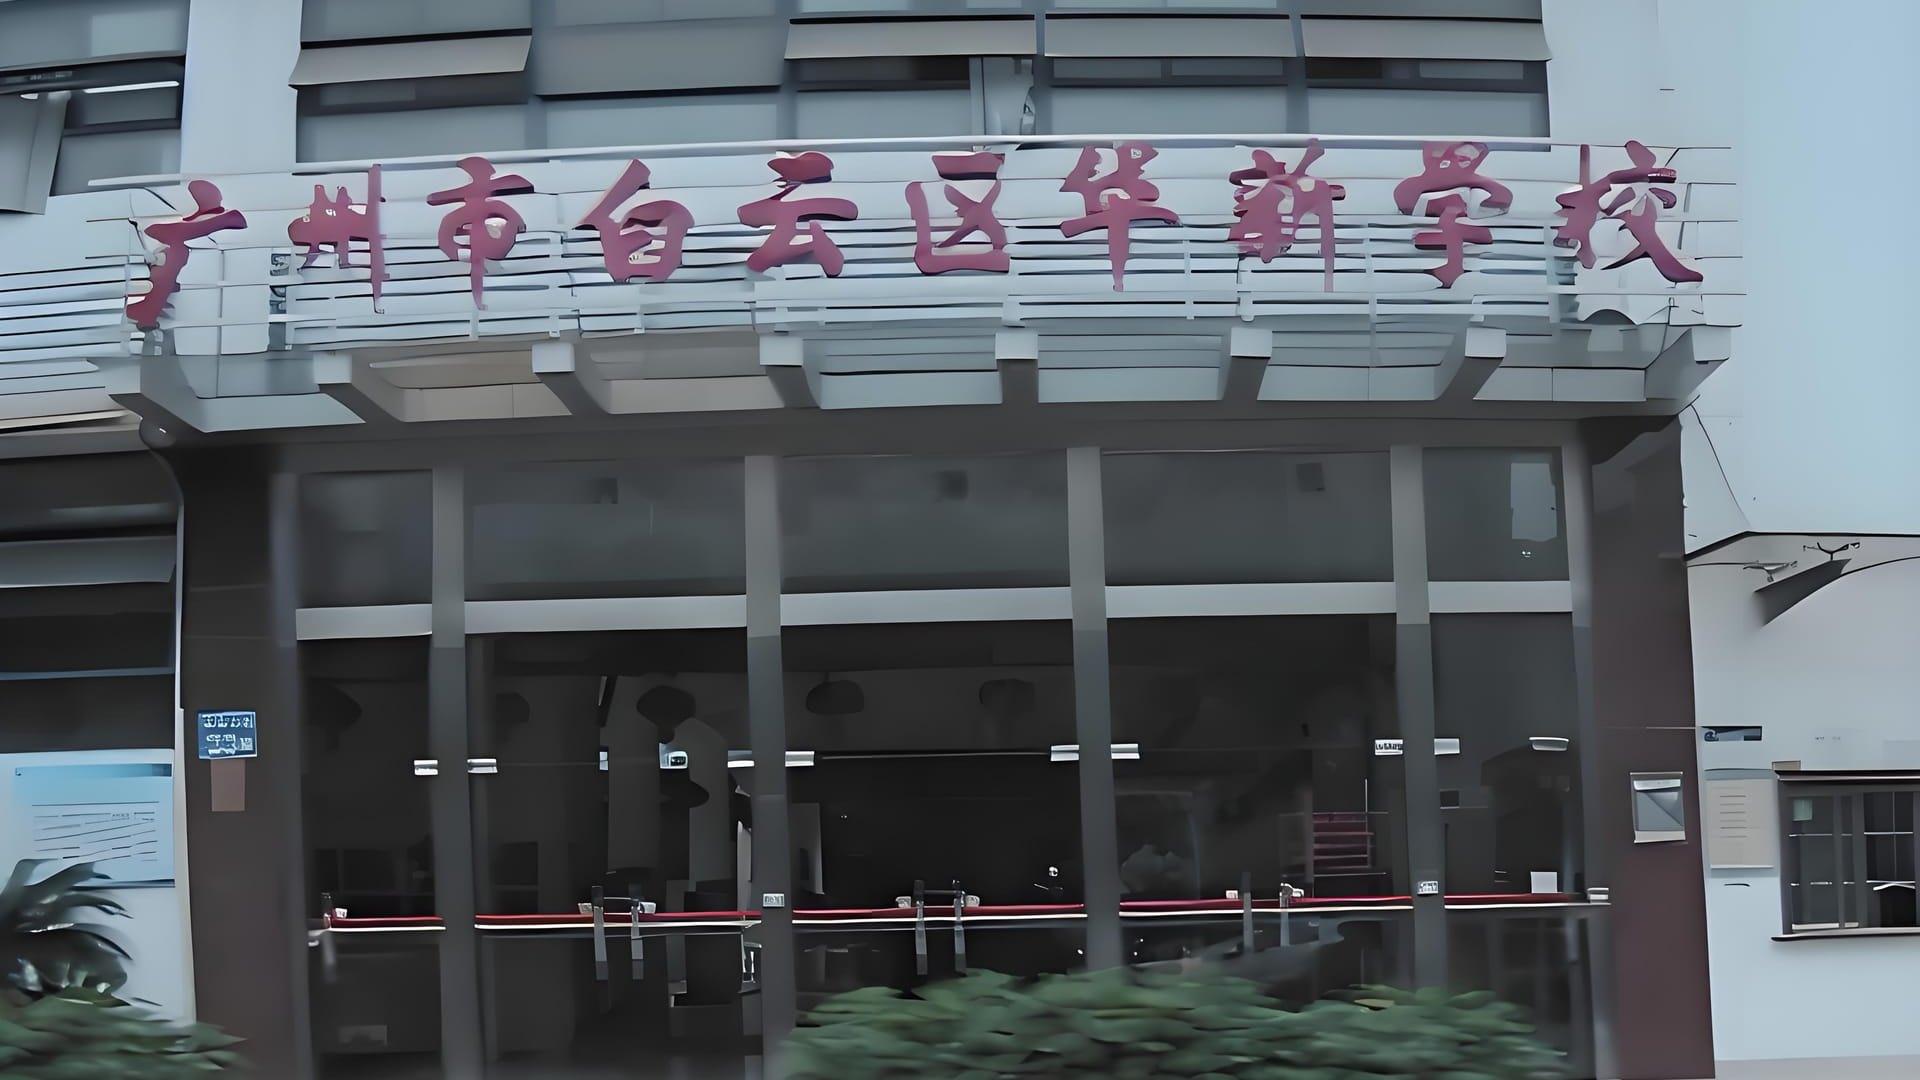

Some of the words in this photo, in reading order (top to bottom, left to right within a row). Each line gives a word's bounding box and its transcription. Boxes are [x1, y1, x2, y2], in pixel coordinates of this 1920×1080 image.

[127, 138, 1703, 328] 广州市白云区华新学校
